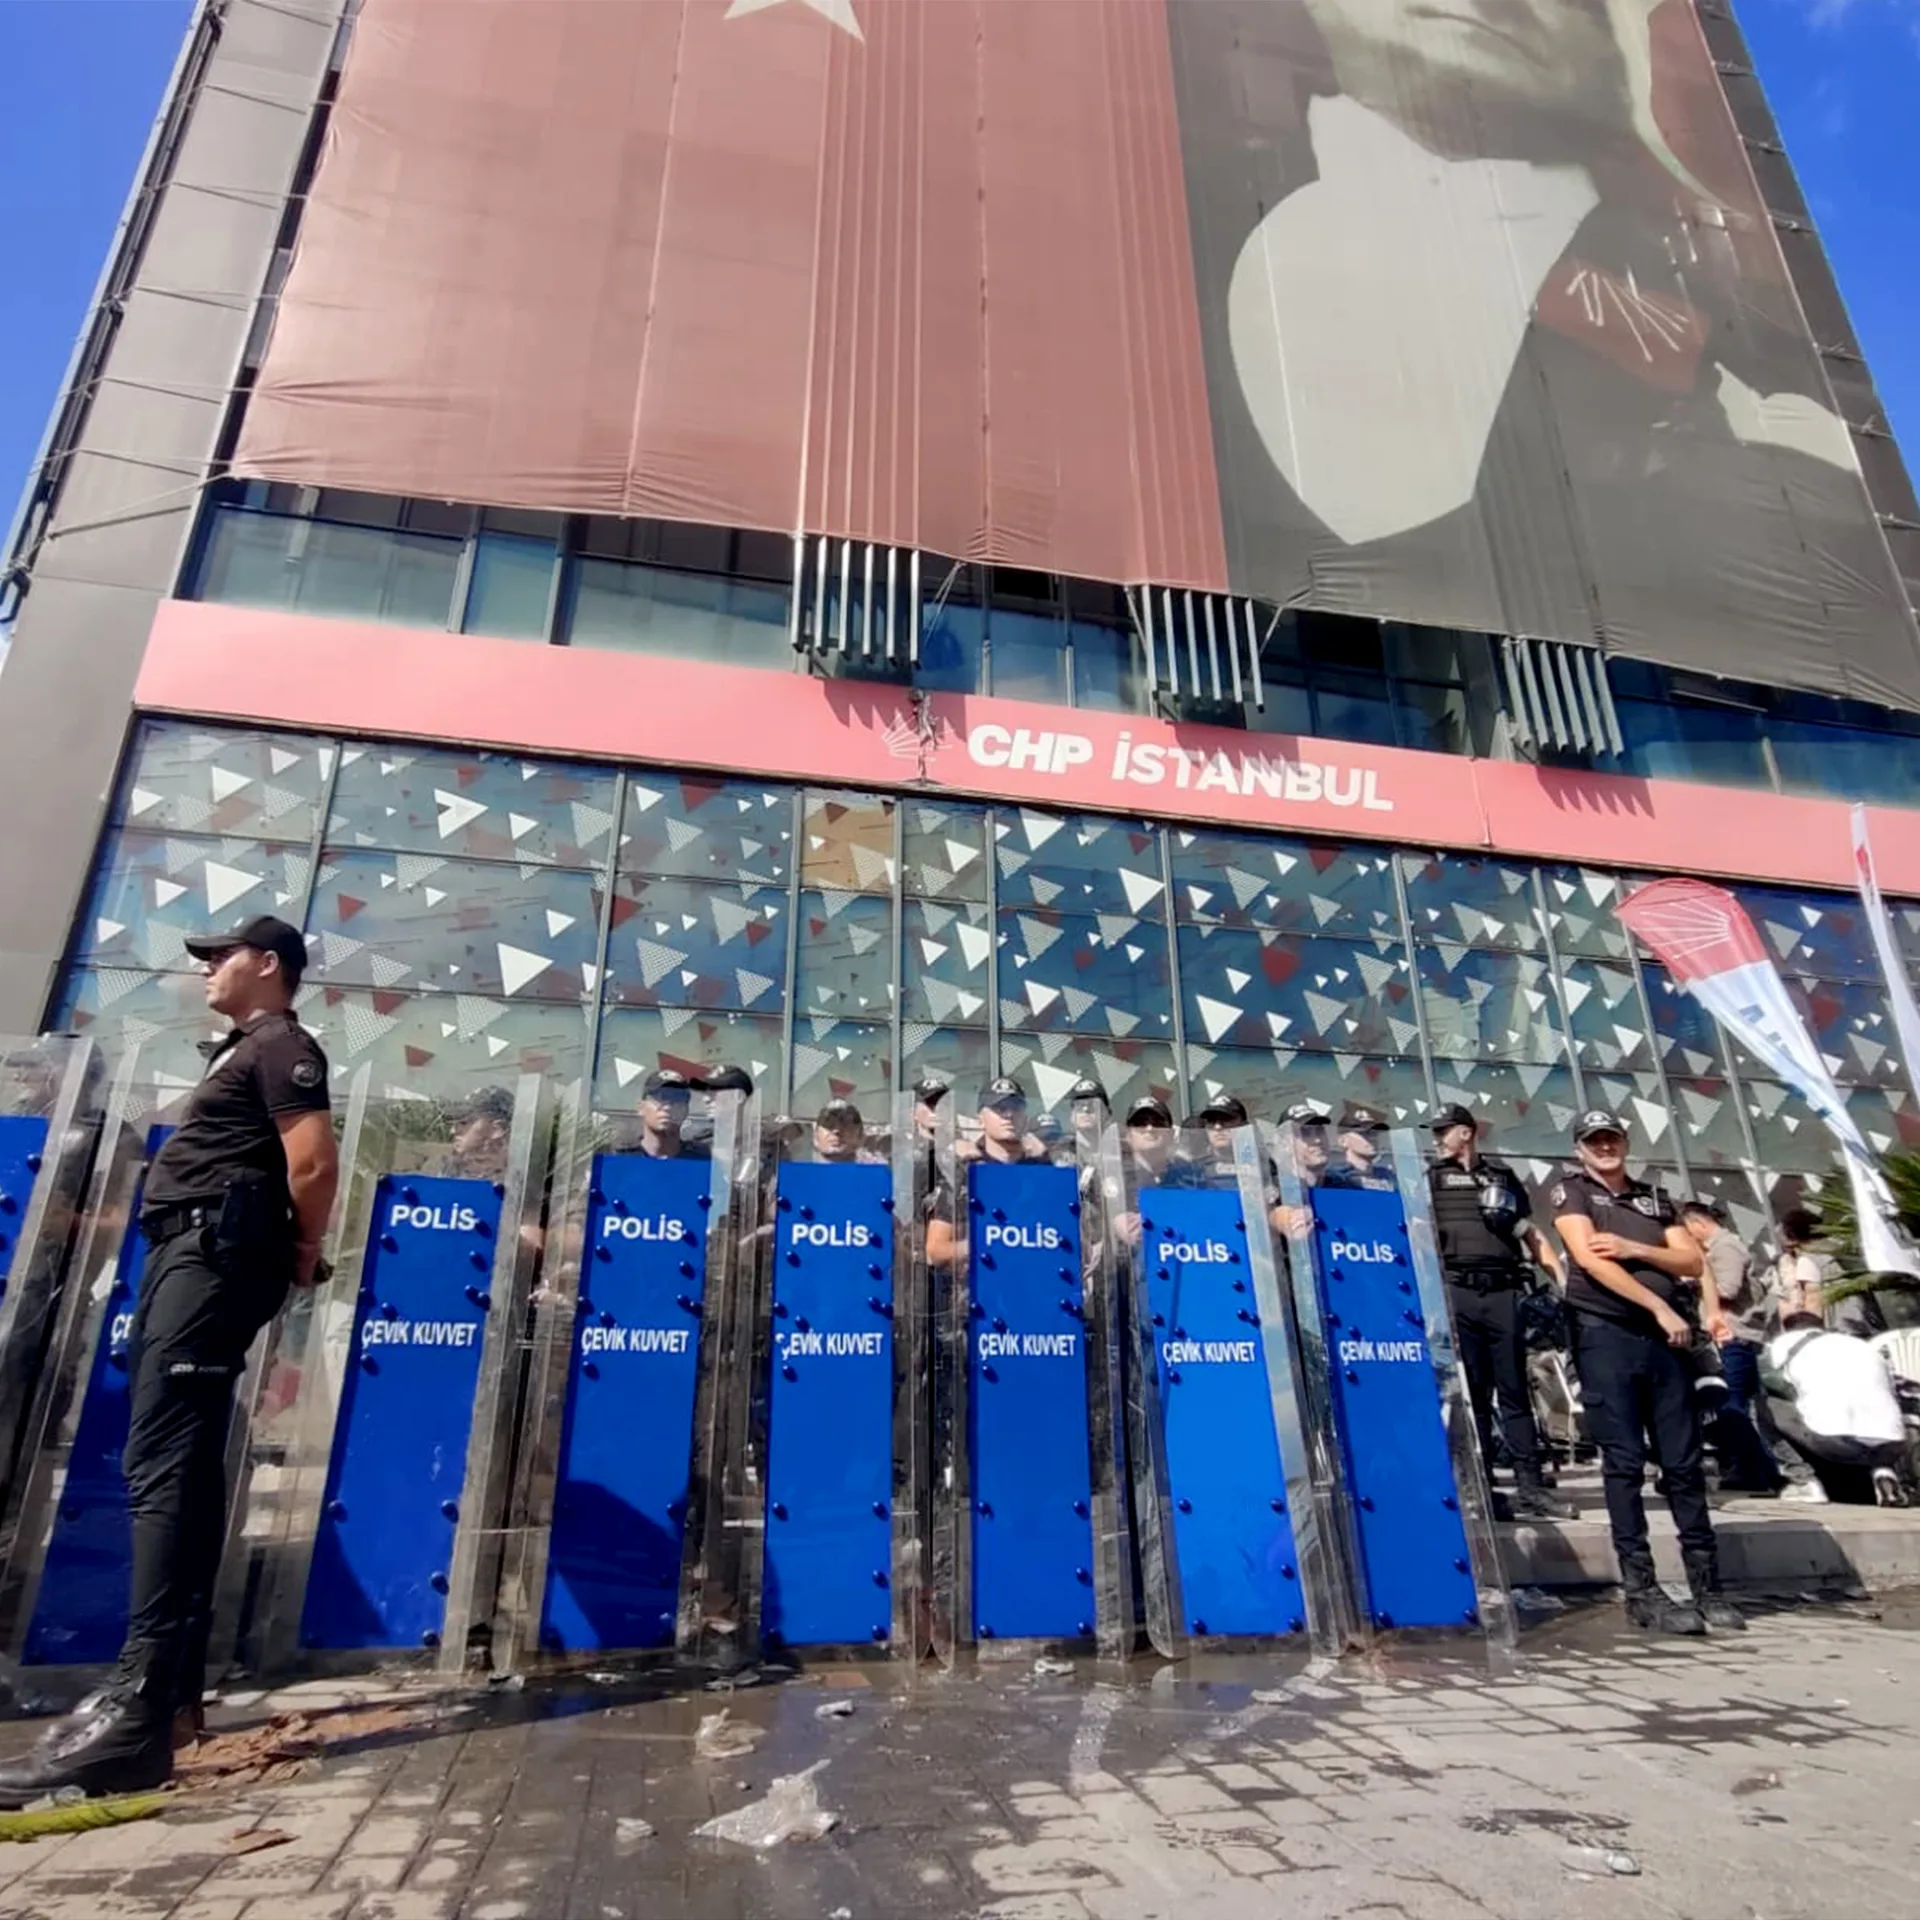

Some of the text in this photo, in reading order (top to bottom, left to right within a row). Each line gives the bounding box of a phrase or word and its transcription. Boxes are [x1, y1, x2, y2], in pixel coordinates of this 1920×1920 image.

[966, 724, 1395, 812] CHP İSTANBUL
[390, 1203, 476, 1231] POLİS
[603, 1213, 684, 1241] POLİS
[792, 1219, 869, 1246] POLİS
[985, 1221, 1059, 1249] POLİS
[1159, 1238, 1230, 1263] POLİS
[1331, 1239, 1395, 1263] POLİS
[412, 1320, 477, 1346] KUVVET
[581, 1323, 688, 1355] ÇEVİK KUVVET
[825, 1332, 883, 1356] KUVVET
[978, 1328, 1076, 1361] ÇEVİK KUVVET
[1162, 1337, 1255, 1367] ÇEVİK KUVVET
[1340, 1336, 1422, 1366] ÇEVİK KUVVET
